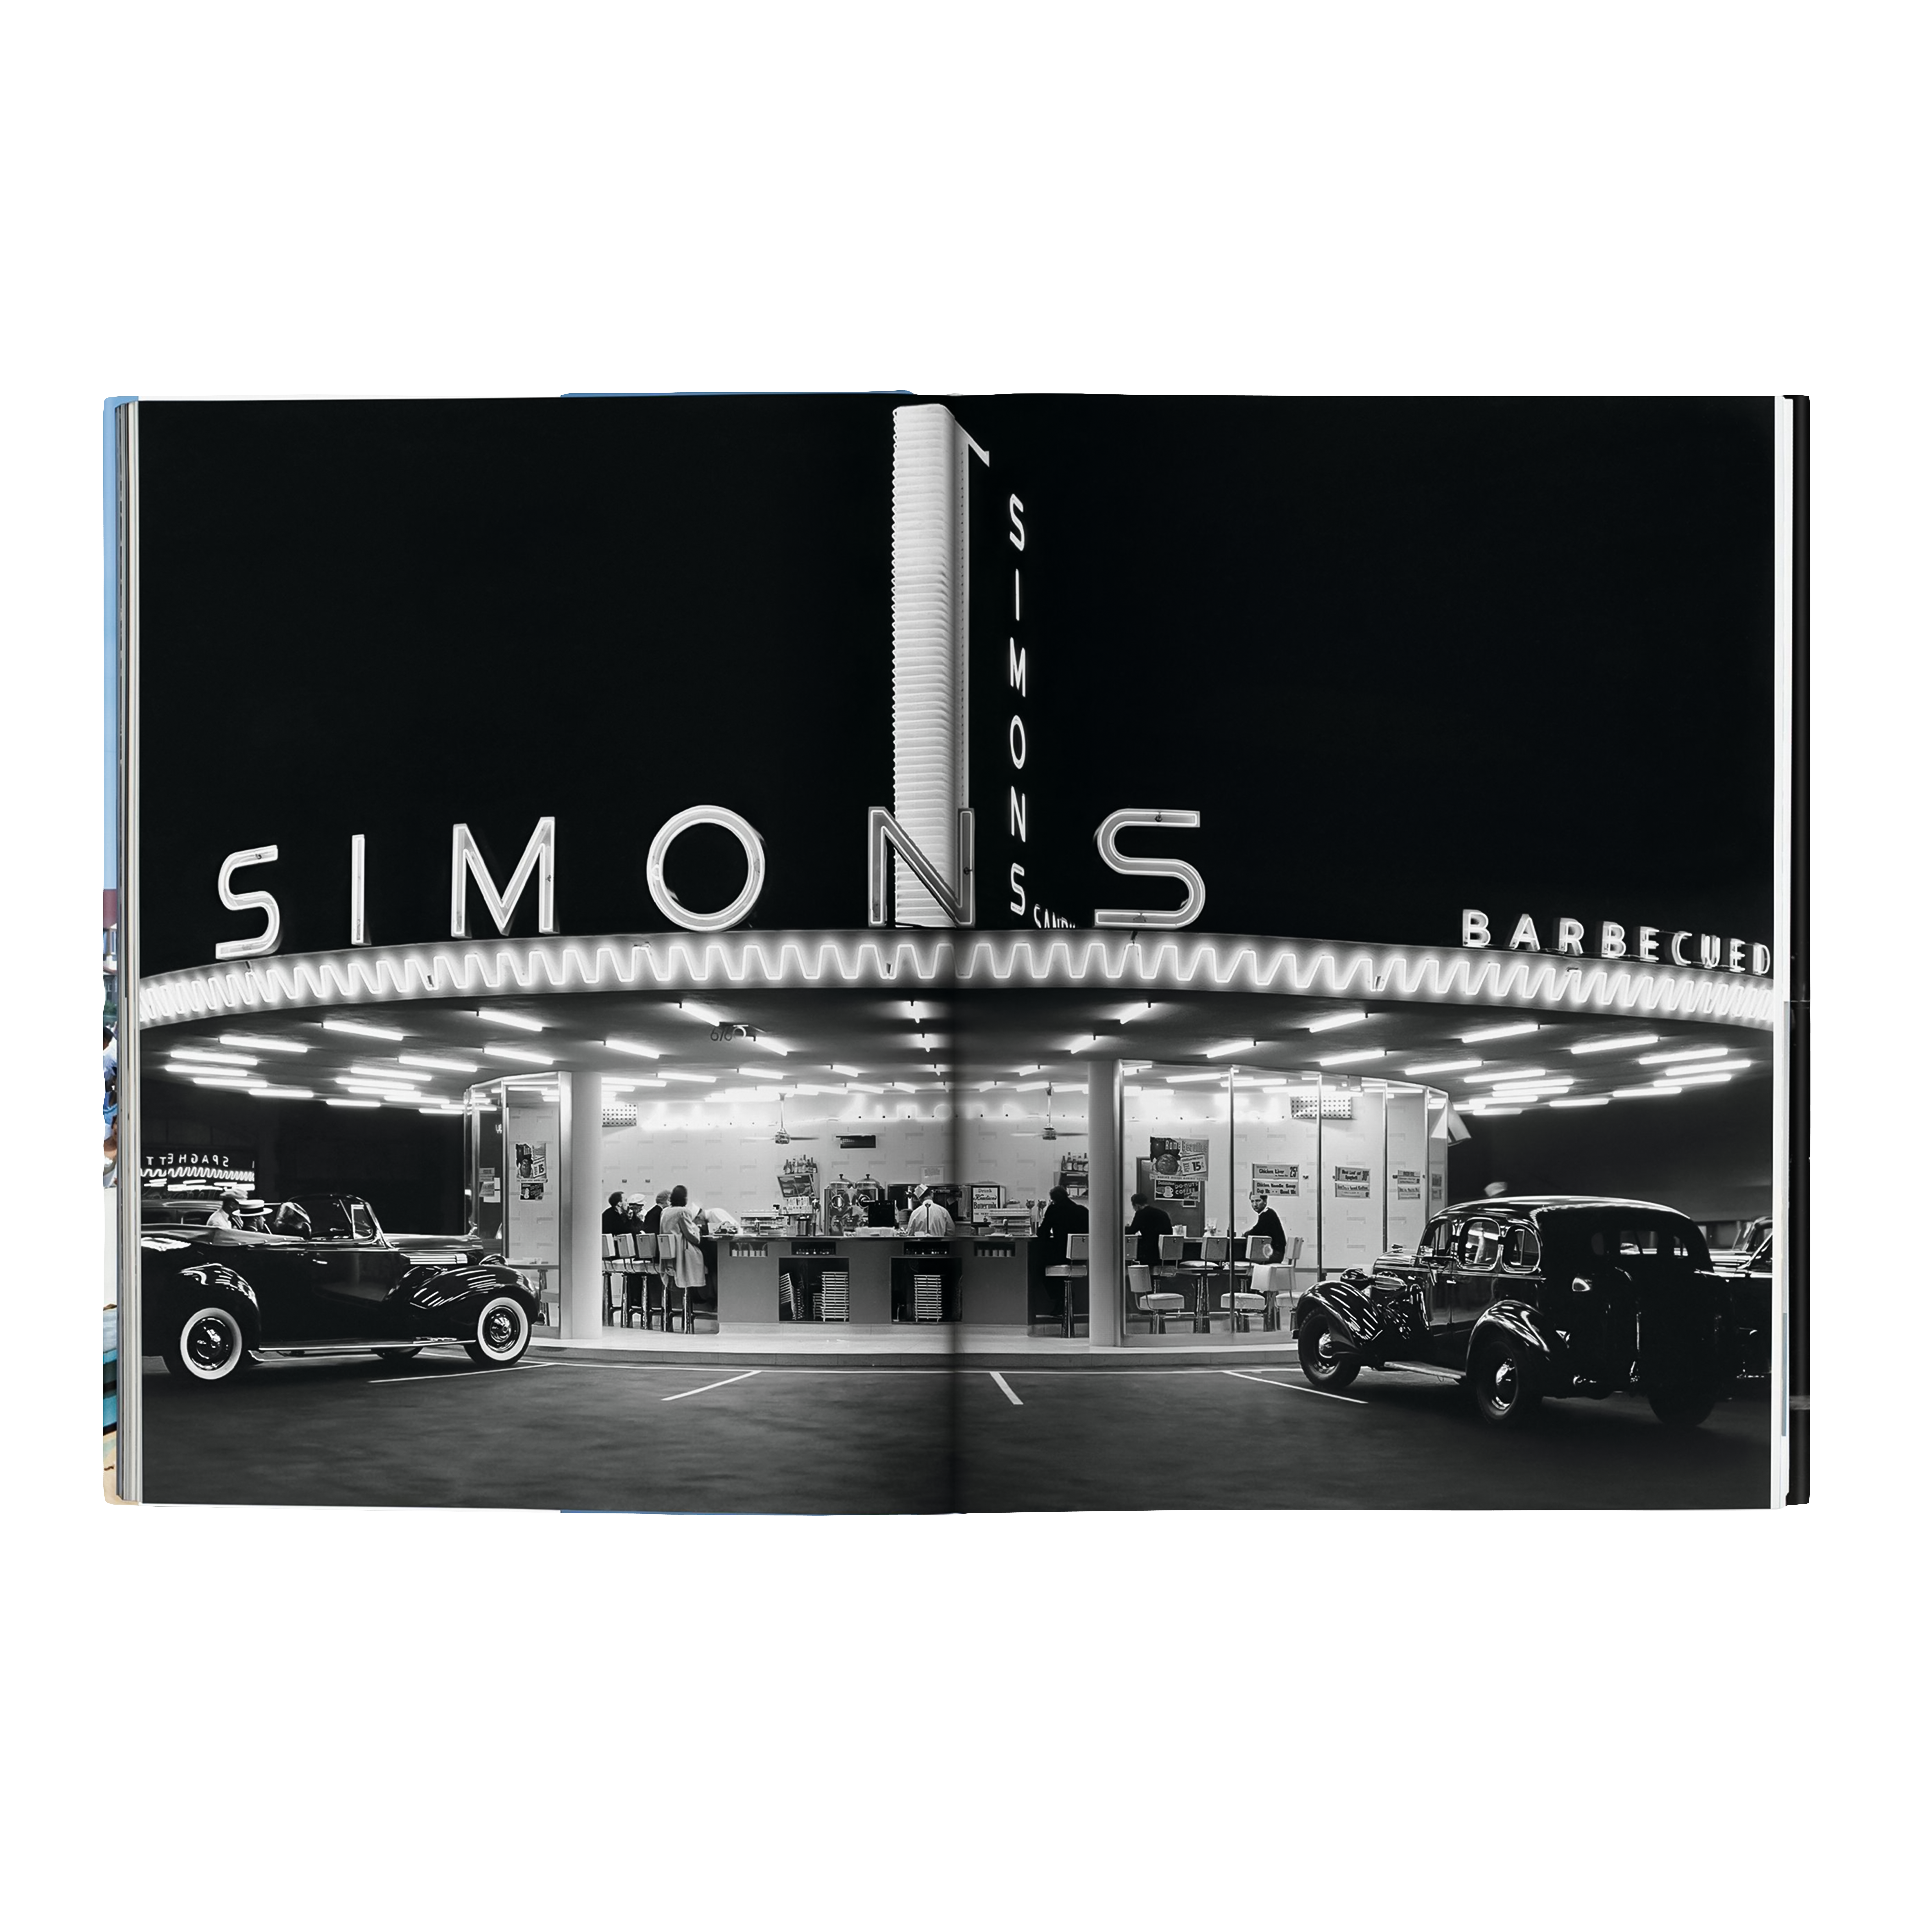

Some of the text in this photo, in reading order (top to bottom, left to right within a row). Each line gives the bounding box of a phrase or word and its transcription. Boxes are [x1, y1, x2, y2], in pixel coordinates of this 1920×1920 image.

[1009, 493, 1027, 917] SIMONS
[215, 804, 1206, 961] SIMONS
[1462, 908, 1773, 976] BARBECUED
